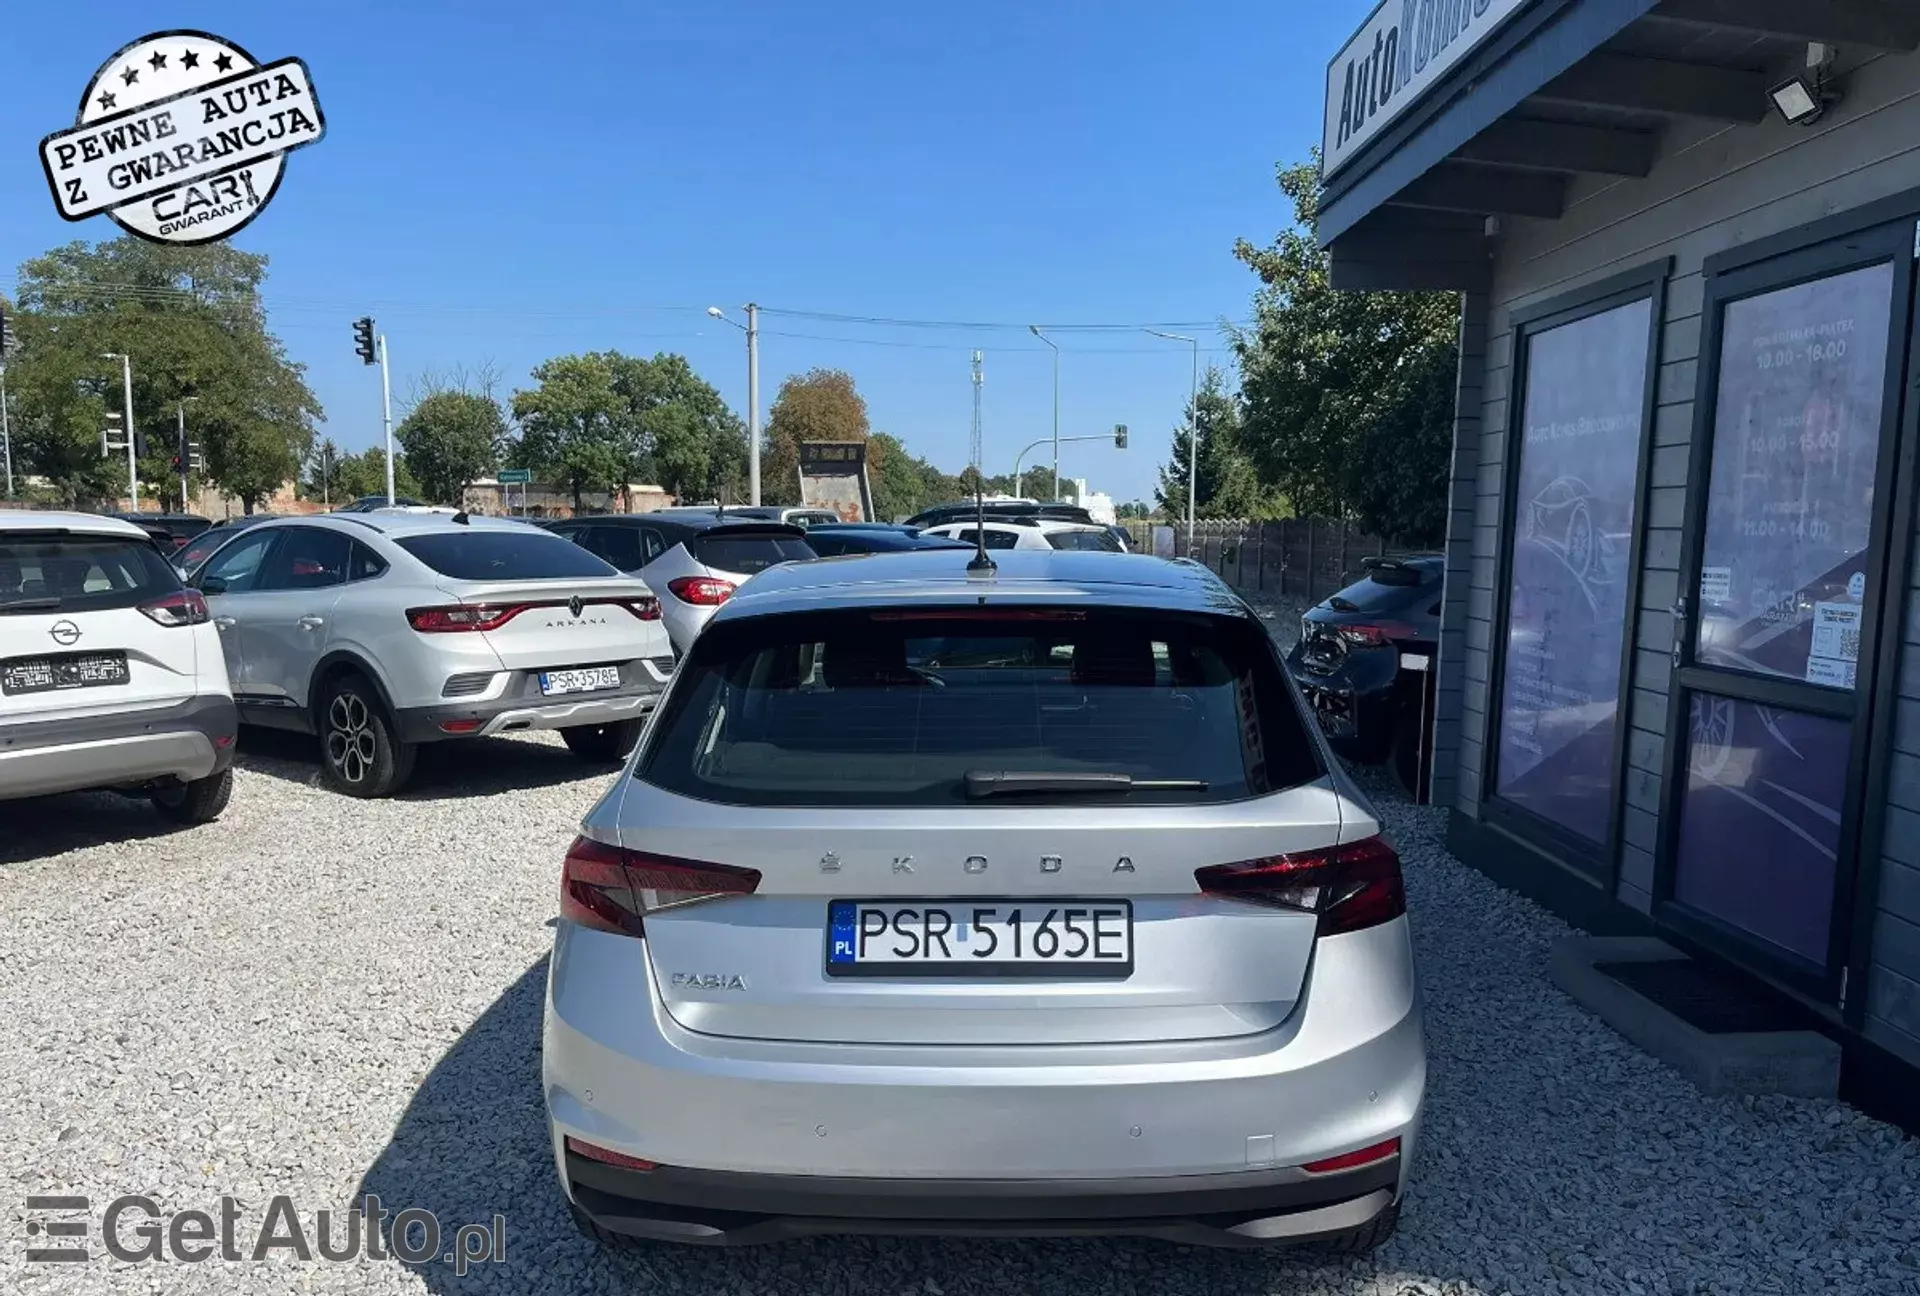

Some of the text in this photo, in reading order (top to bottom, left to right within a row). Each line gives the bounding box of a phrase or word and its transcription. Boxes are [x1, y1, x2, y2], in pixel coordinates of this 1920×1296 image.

[546, 618, 607, 628] ARKANA
[549, 668, 619, 689] PSR 3578E
[859, 908, 1123, 958] PSR 5165E
[835, 941, 852, 955] PL
[671, 972, 747, 991] FABIA
